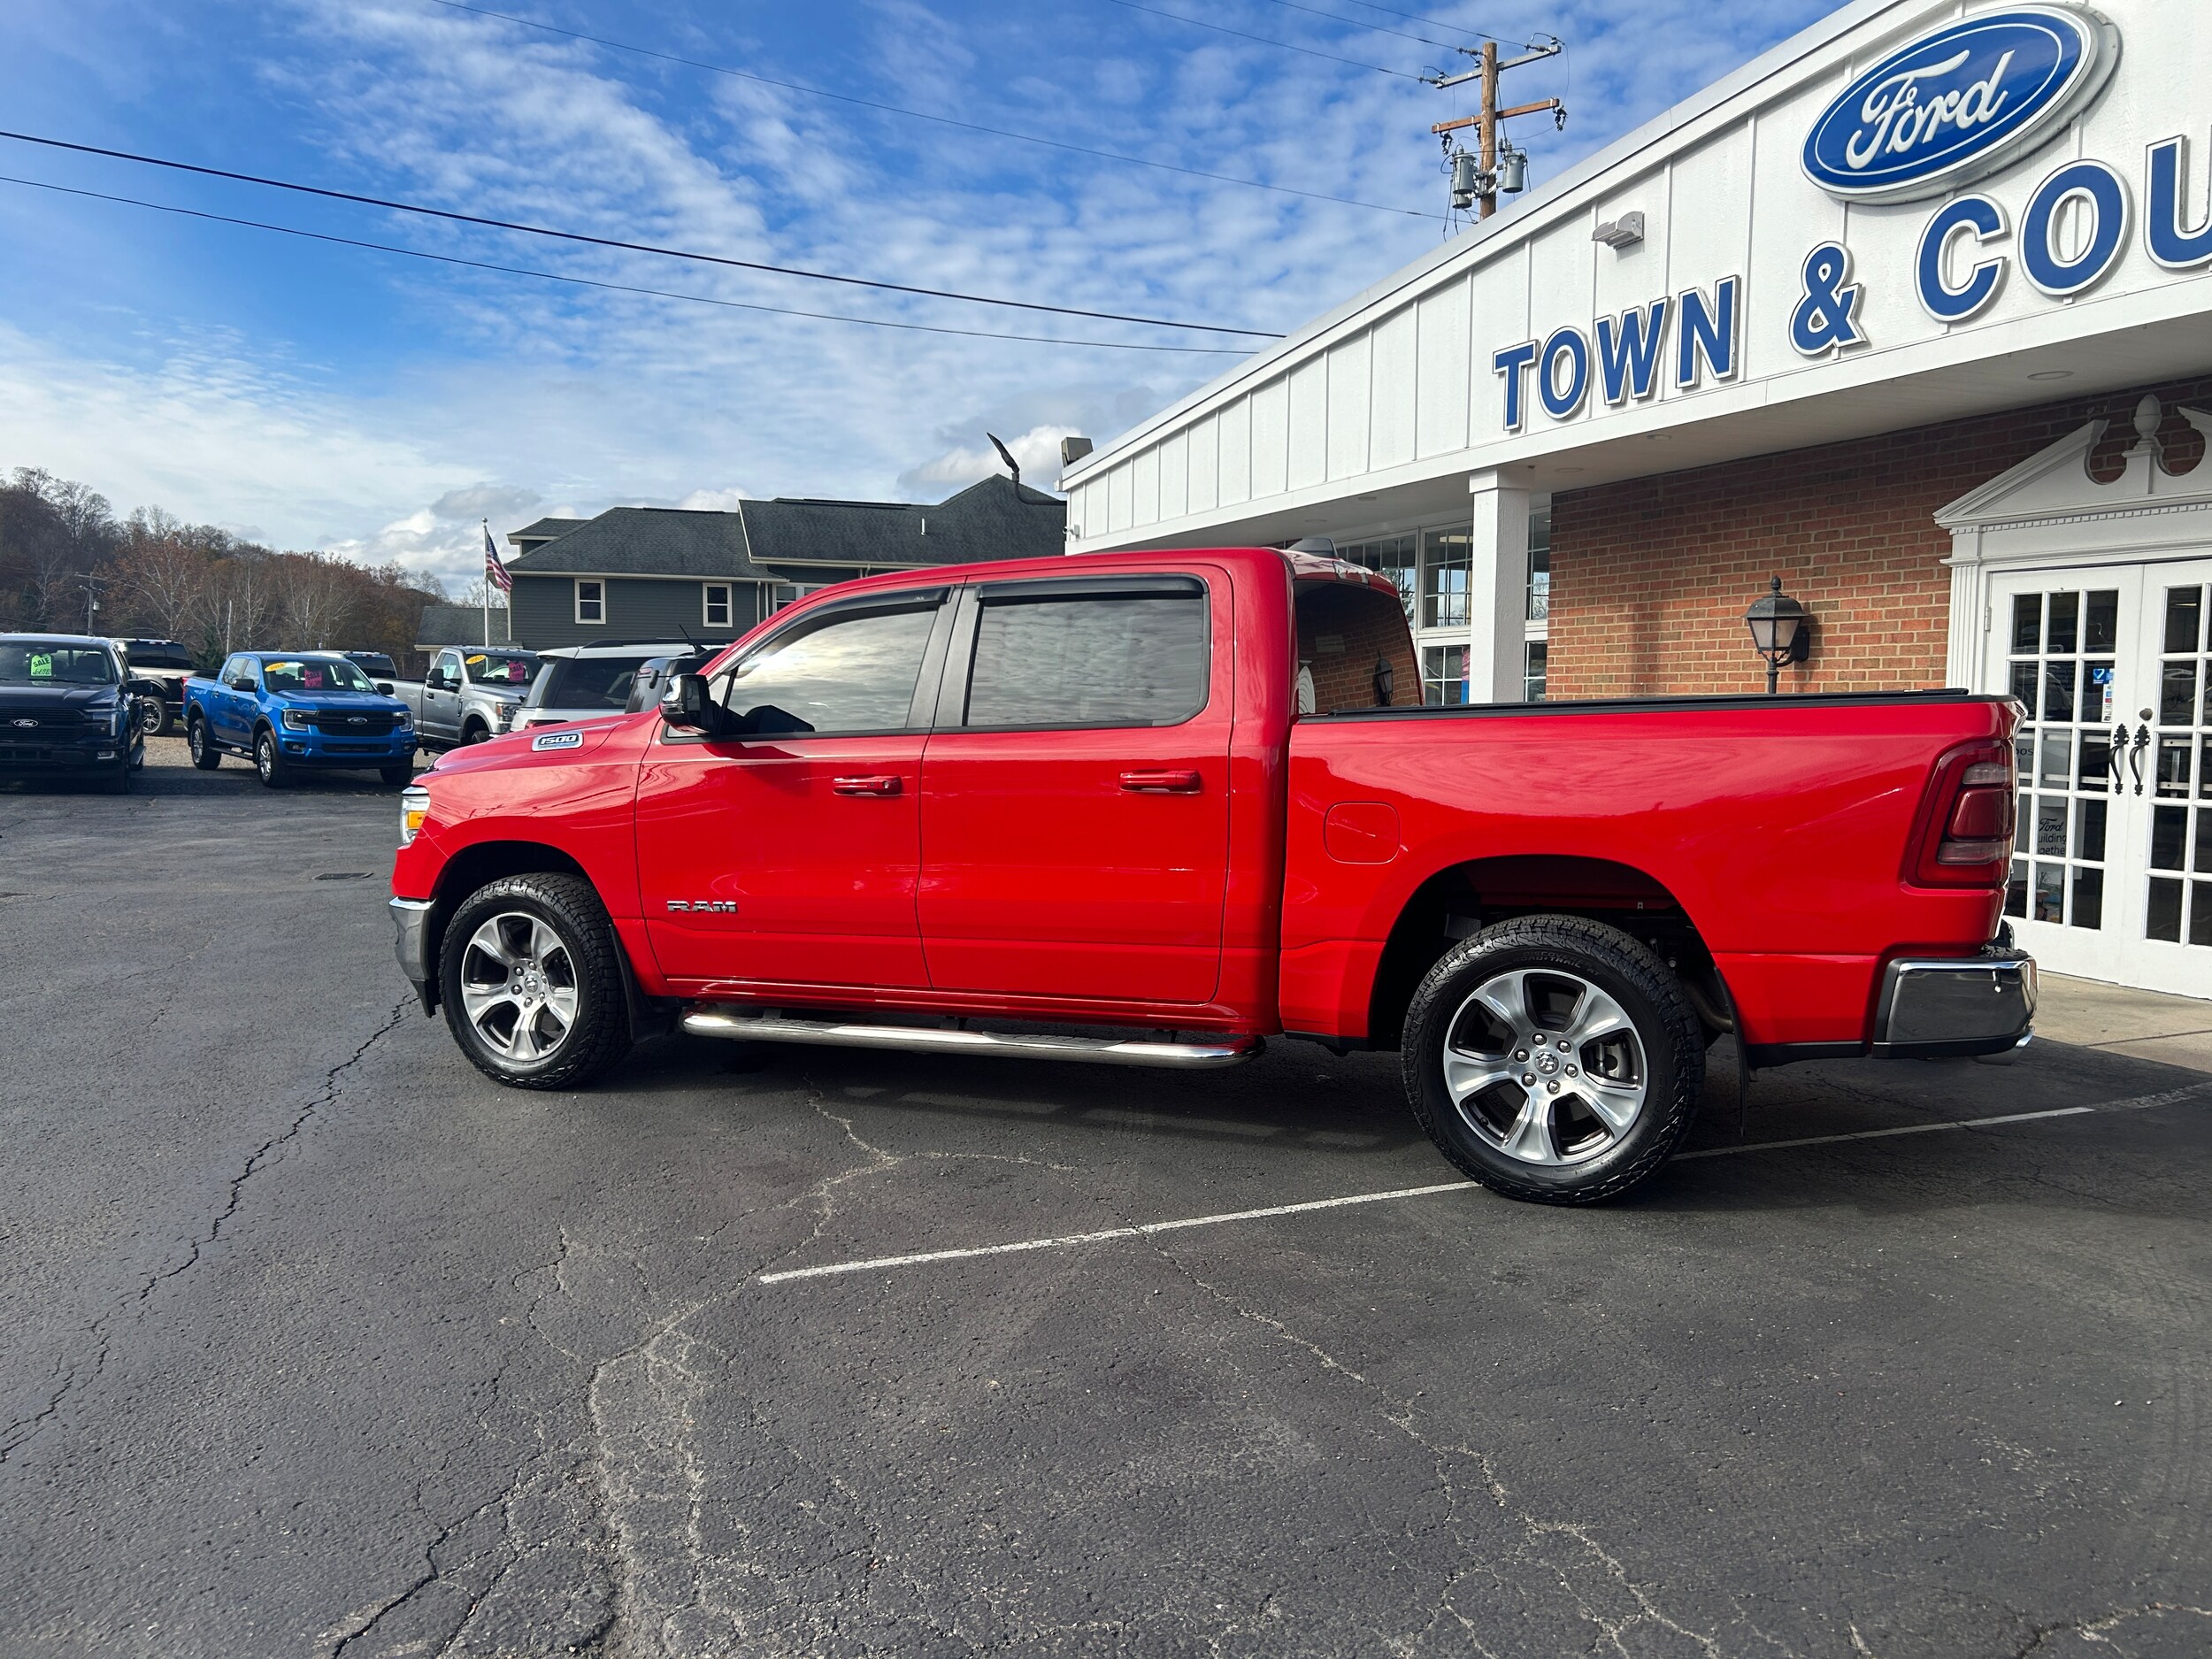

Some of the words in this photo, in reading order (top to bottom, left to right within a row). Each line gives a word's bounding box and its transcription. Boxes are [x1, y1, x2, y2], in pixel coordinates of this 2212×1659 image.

[1846, 50, 2016, 170] Ford
[1494, 276, 1737, 431] TOWN
[1788, 241, 1865, 355] &
[33, 657, 50, 667] SALE
[540, 734, 578, 745] 1500
[2039, 818, 2063, 831] Ford
[2039, 834, 2067, 844] uilding
[666, 901, 737, 912] RAM
